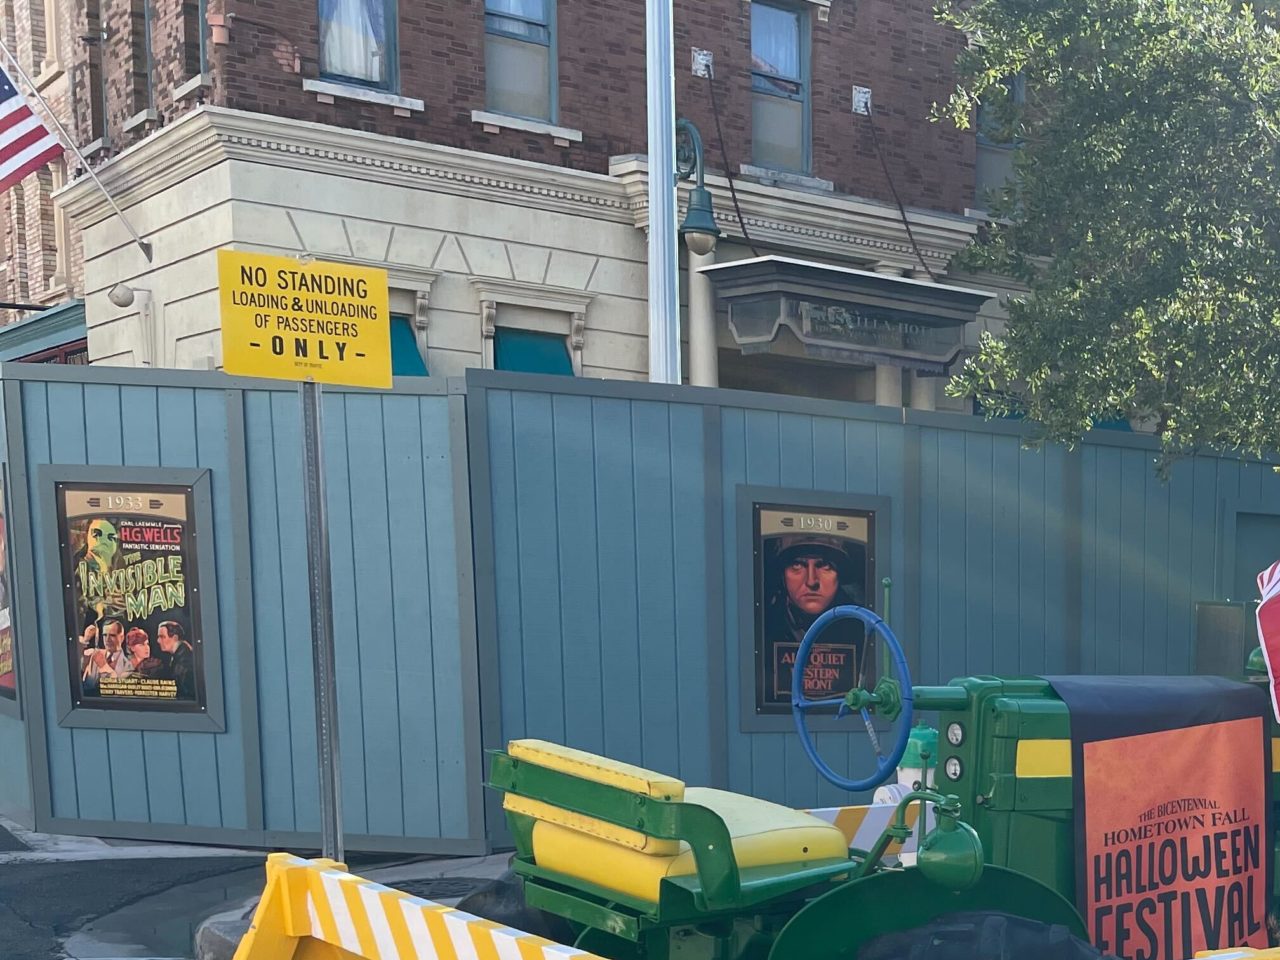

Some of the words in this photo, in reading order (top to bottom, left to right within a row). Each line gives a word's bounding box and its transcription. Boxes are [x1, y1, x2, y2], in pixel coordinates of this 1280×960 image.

[240, 265, 267, 288] NO
[277, 269, 368, 299] STANDING
[232, 290, 288, 310] LOADING
[291, 297, 304, 312] &
[305, 298, 377, 320] UNLOADING
[255, 313, 271, 329] OF
[277, 315, 358, 338] PASSENGERS
[107, 496, 143, 510] 1933
[800, 517, 832, 531] 1930
[79, 555, 183, 598] INVISIBLE
[125, 582, 185, 622] MAN
[810, 653, 845, 665] QUIET
[803, 667, 840, 679] STERN
[803, 679, 833, 691] RONT
[1138, 808, 1155, 823] THE
[1157, 797, 1220, 818] BICENTENNIAL
[1103, 814, 1205, 847] HOMETOWN
[1211, 807, 1250, 827] FALL
[1093, 824, 1260, 903] HALLOWEEN
